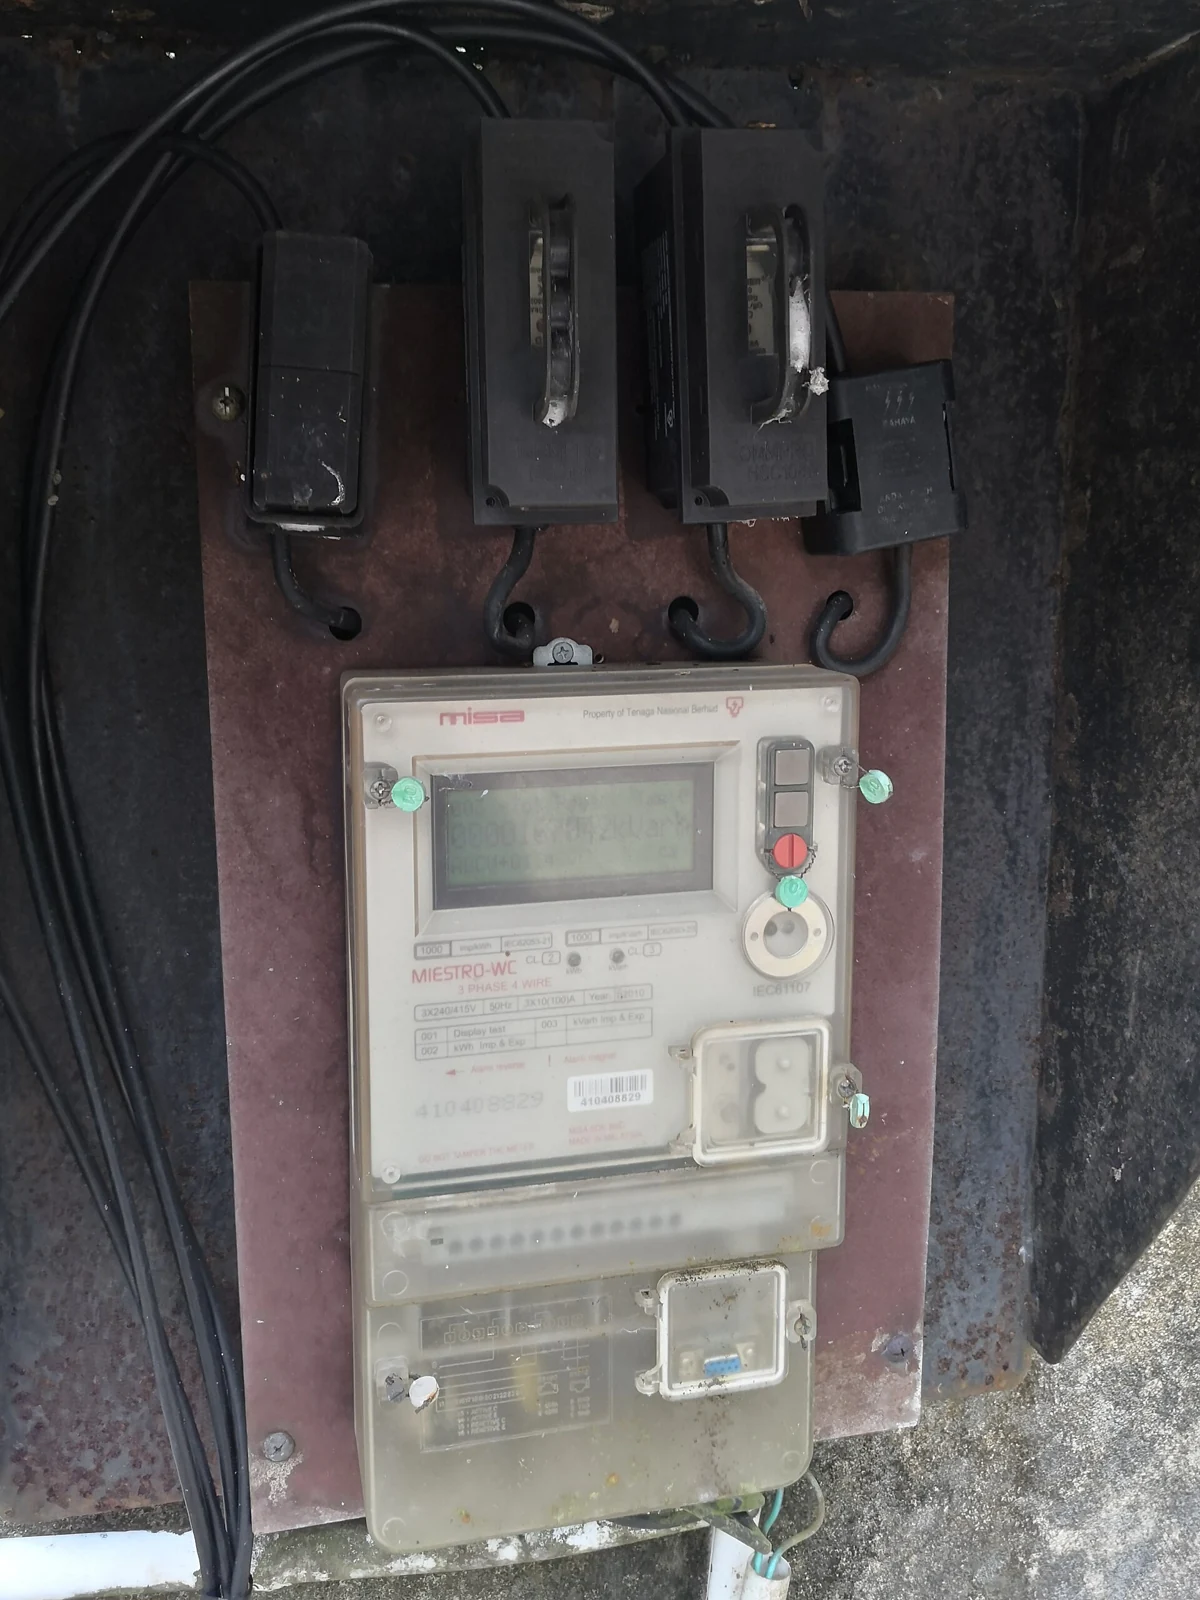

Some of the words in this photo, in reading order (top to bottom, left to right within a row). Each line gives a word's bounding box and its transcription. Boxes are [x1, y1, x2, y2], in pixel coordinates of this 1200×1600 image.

[882, 416, 916, 427] AHAYA
[583, 709, 615, 720] Property
[617, 708, 624, 717] of
[627, 707, 655, 718] Tenaga
[657, 705, 690, 716] Nasional
[571, 932, 593, 942] 1000
[421, 945, 443, 955] 1000
[412, 960, 517, 985] MIESTRO-WC
[458, 985, 464, 995] 3
[468, 982, 509, 993] PHASE
[511, 981, 518, 989] 4
[521, 977, 552, 988] WIRE
[752, 981, 811, 997] IEC61107
[489, 1001, 512, 1012] 50Hz
[524, 995, 576, 1008] 3X10(100)A
[421, 1003, 477, 1018] 3X240/415V
[541, 1019, 558, 1029] 003
[573, 1015, 598, 1026] kVarh
[600, 1015, 617, 1025] Imp
[619, 1013, 626, 1021] &
[628, 1012, 645, 1022] Exp
[421, 1031, 438, 1041] 001
[453, 1027, 487, 1039] Display
[489, 1025, 506, 1034] test
[421, 1046, 438, 1056] 002
[453, 1042, 474, 1052] kWh
[479, 1041, 497, 1051] Imp
[499, 1039, 506, 1047] &
[508, 1037, 526, 1048] Exp
[415, 1090, 544, 1120] 410408829
[580, 1092, 642, 1108] 410408829
